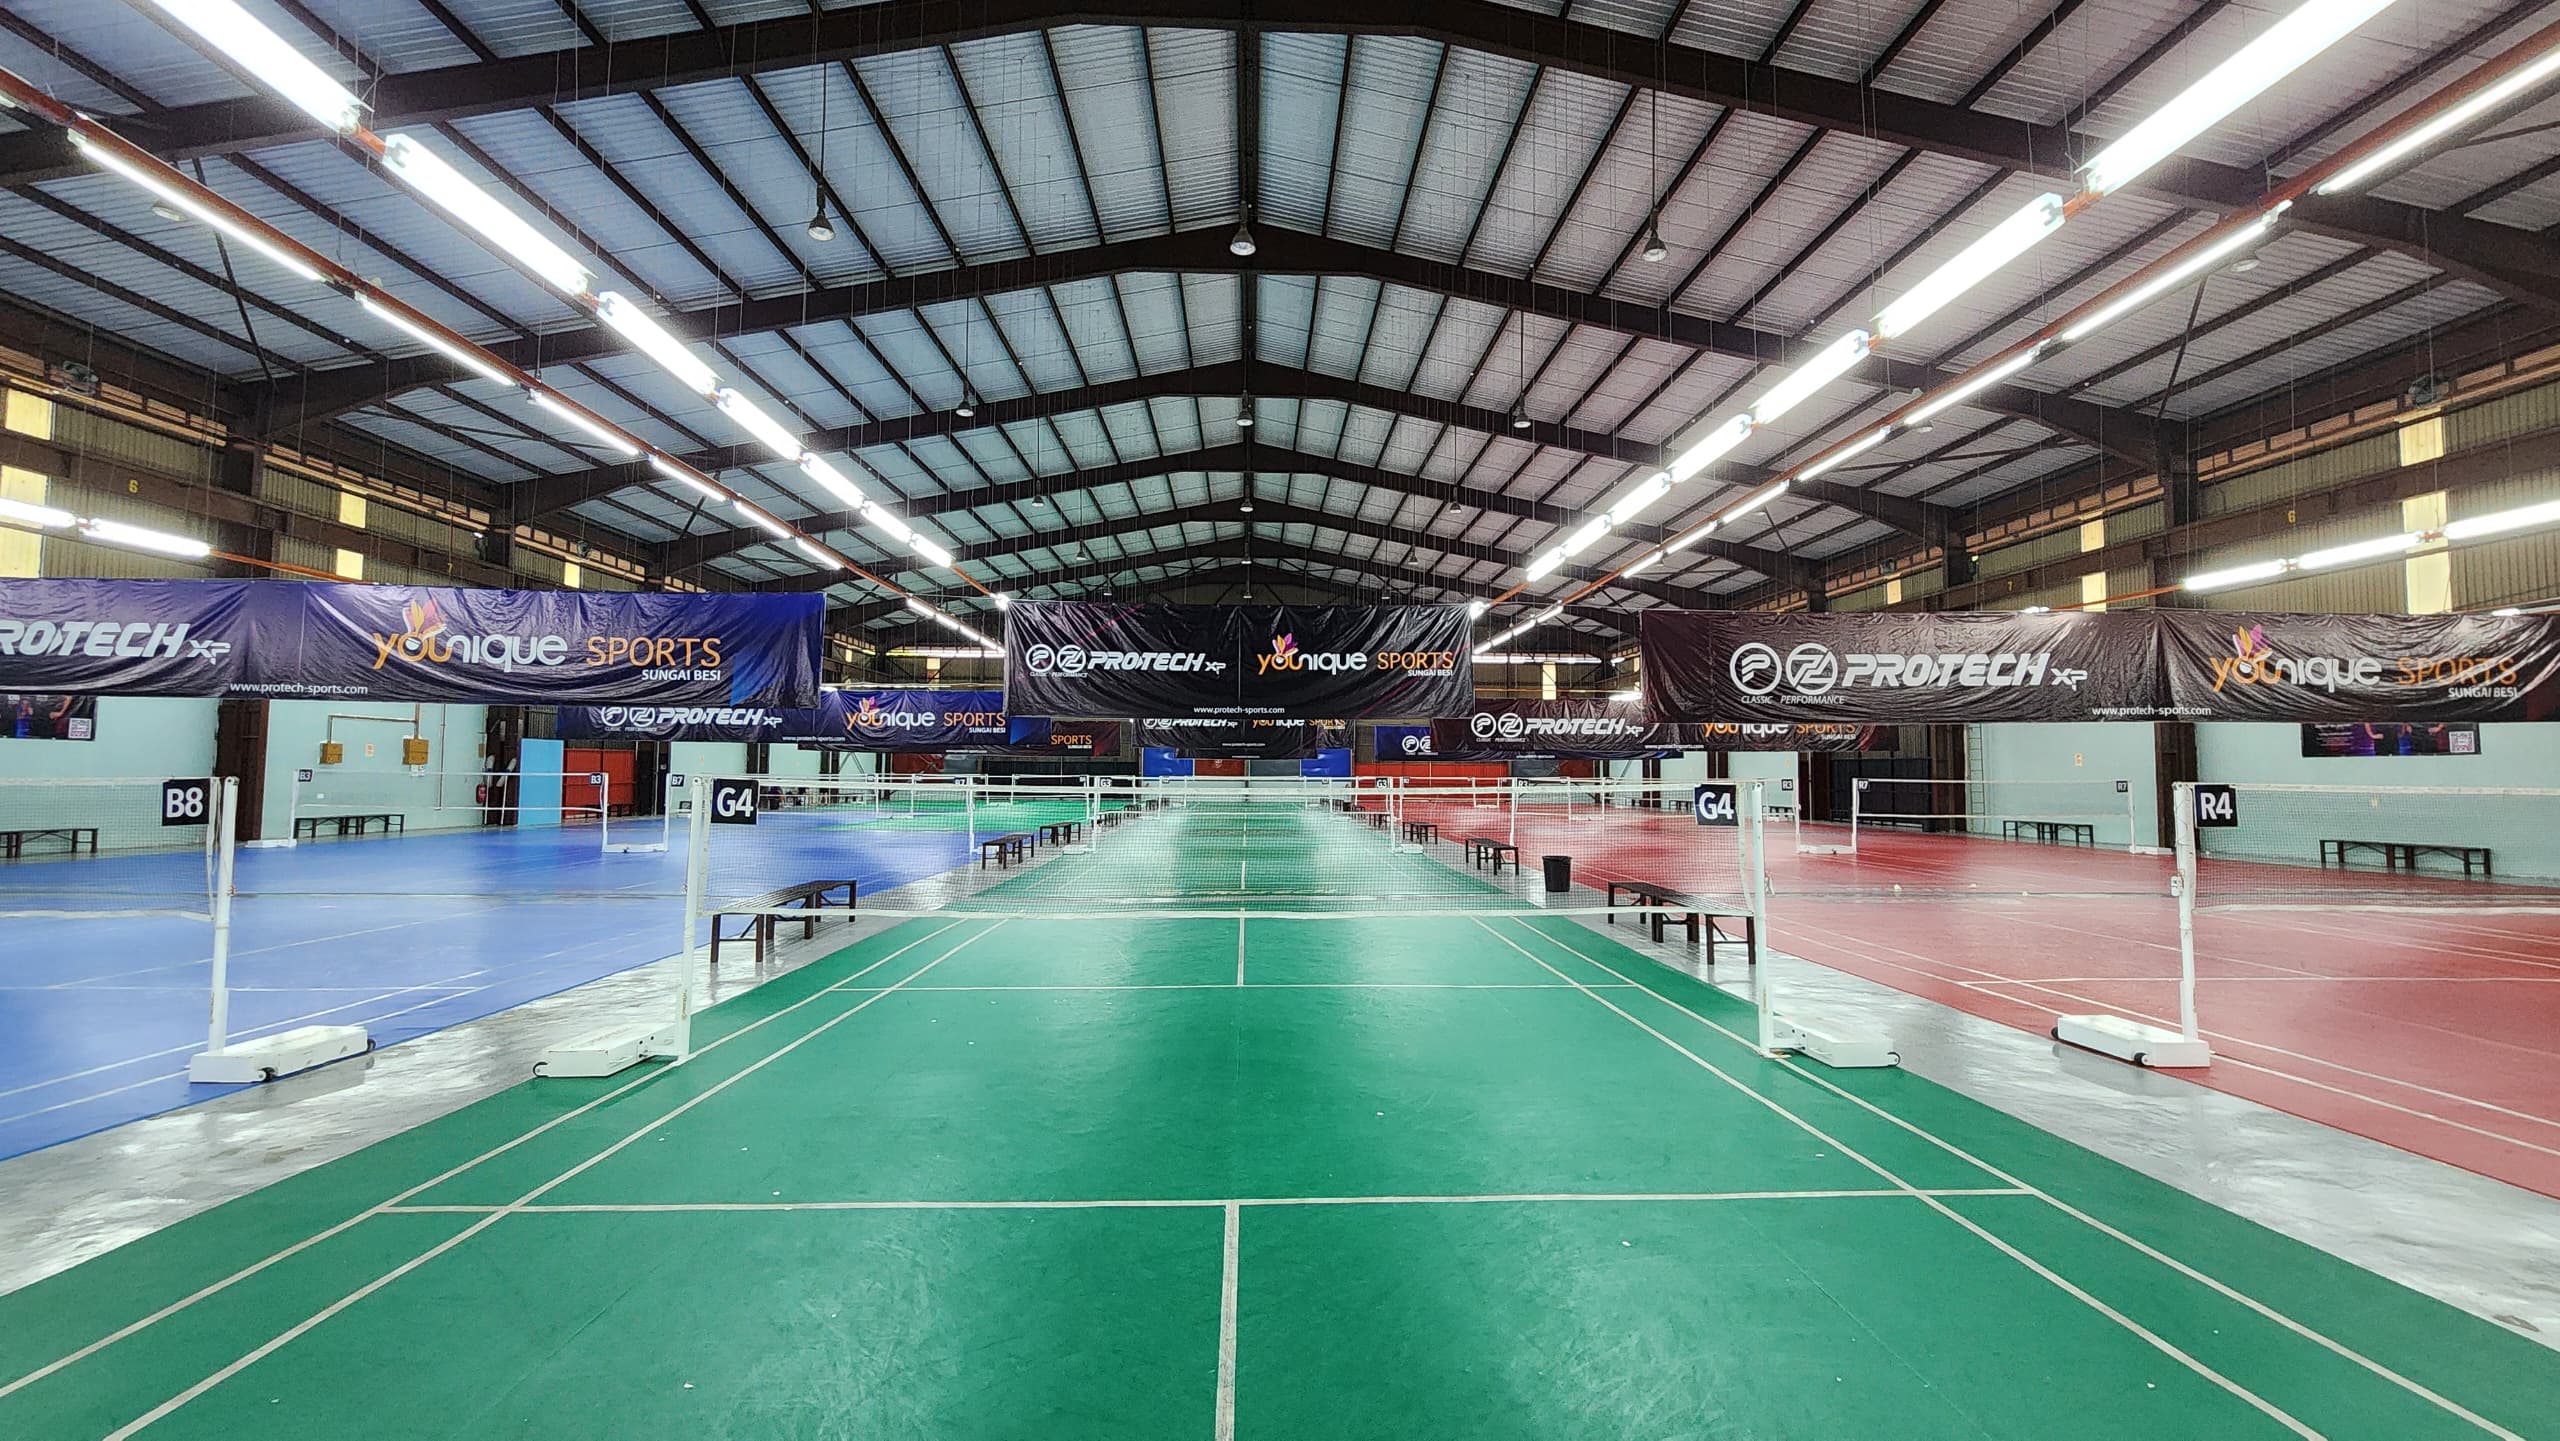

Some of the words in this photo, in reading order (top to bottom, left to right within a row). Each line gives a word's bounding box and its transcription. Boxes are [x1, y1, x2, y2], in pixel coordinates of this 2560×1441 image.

[0, 619, 191, 658] ROTECH
[187, 639, 232, 665] XP
[585, 636, 721, 667] SPORTS
[1088, 651, 1206, 672] PROTECH
[1204, 661, 1227, 675] XP
[1377, 652, 1454, 670] SPORTS
[641, 669, 691, 681] SUNGAI
[694, 669, 721, 681] BESI
[1407, 669, 1436, 677] SUNGAI
[1437, 669, 1454, 677] BESI
[1841, 653, 2051, 687] PROTECH
[2050, 668, 2088, 691] XP
[2396, 657, 2518, 686] SPORTS
[230, 682, 368, 695] www.protech-sports.com
[2448, 686, 2493, 698] SUNGAI
[2494, 687, 2519, 698] BESI
[1740, 695, 1774, 705] CLASSIC
[1780, 695, 1844, 705] PERFORMANCE
[656, 707, 764, 725] PROTECH
[1193, 706, 1285, 715] www.protech-sports.com
[2091, 705, 2212, 717] www.protech-sports.com
[943, 712, 1006, 727] SPORTS
[1524, 718, 1626, 735] PROTECH
[1051, 735, 1093, 745] SPORTS
[591, 775, 602, 784] B3
[672, 776, 683, 785] B7
[2118, 782, 2127, 791] R7
[166, 787, 204, 818] B8
[716, 787, 754, 818] G4
[1699, 791, 1735, 820] G4
[2199, 791, 2234, 820] R4
